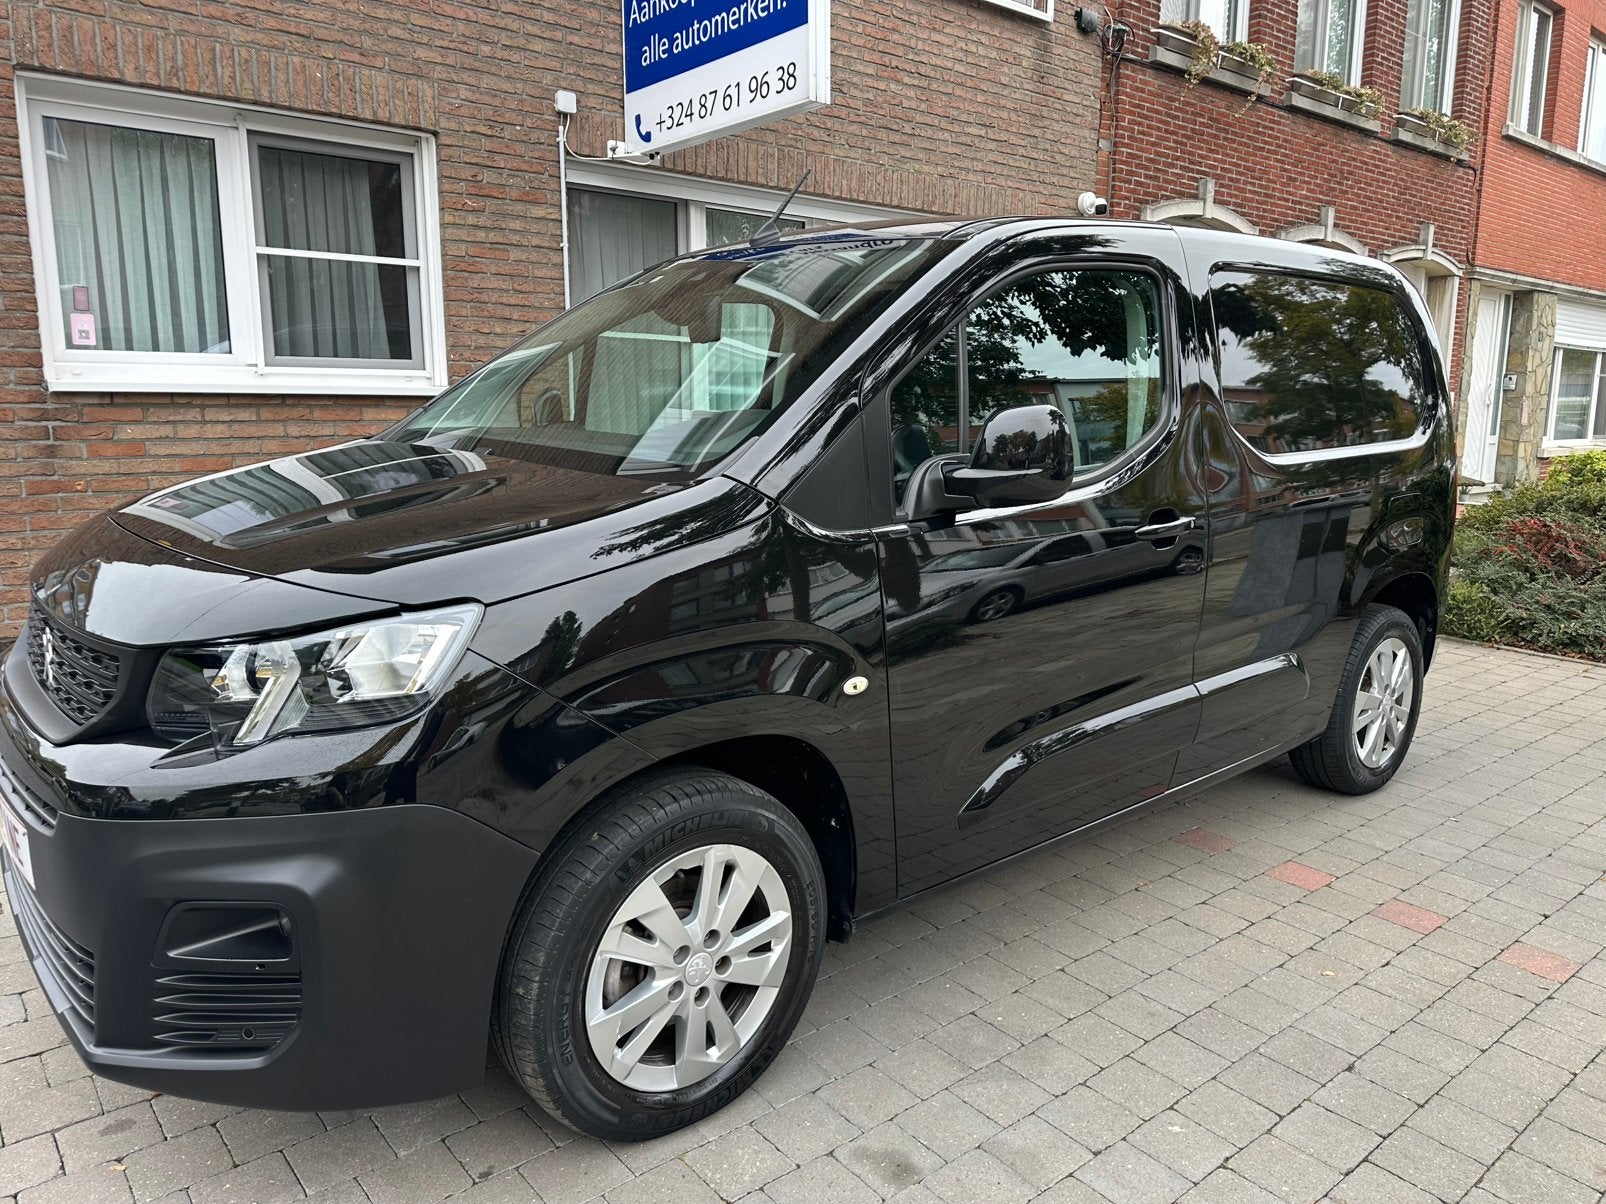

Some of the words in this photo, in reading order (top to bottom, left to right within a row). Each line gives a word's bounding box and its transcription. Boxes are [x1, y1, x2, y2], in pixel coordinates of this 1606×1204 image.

[629, 0, 695, 28] Aank
[641, 33, 669, 67] alle
[698, 89, 718, 119] 87
[722, 81, 740, 111] 61
[748, 71, 770, 103] 96
[776, 62, 797, 94] 38
[644, 810, 748, 860] MICHELIN
[558, 990, 574, 1067] ENERGY
